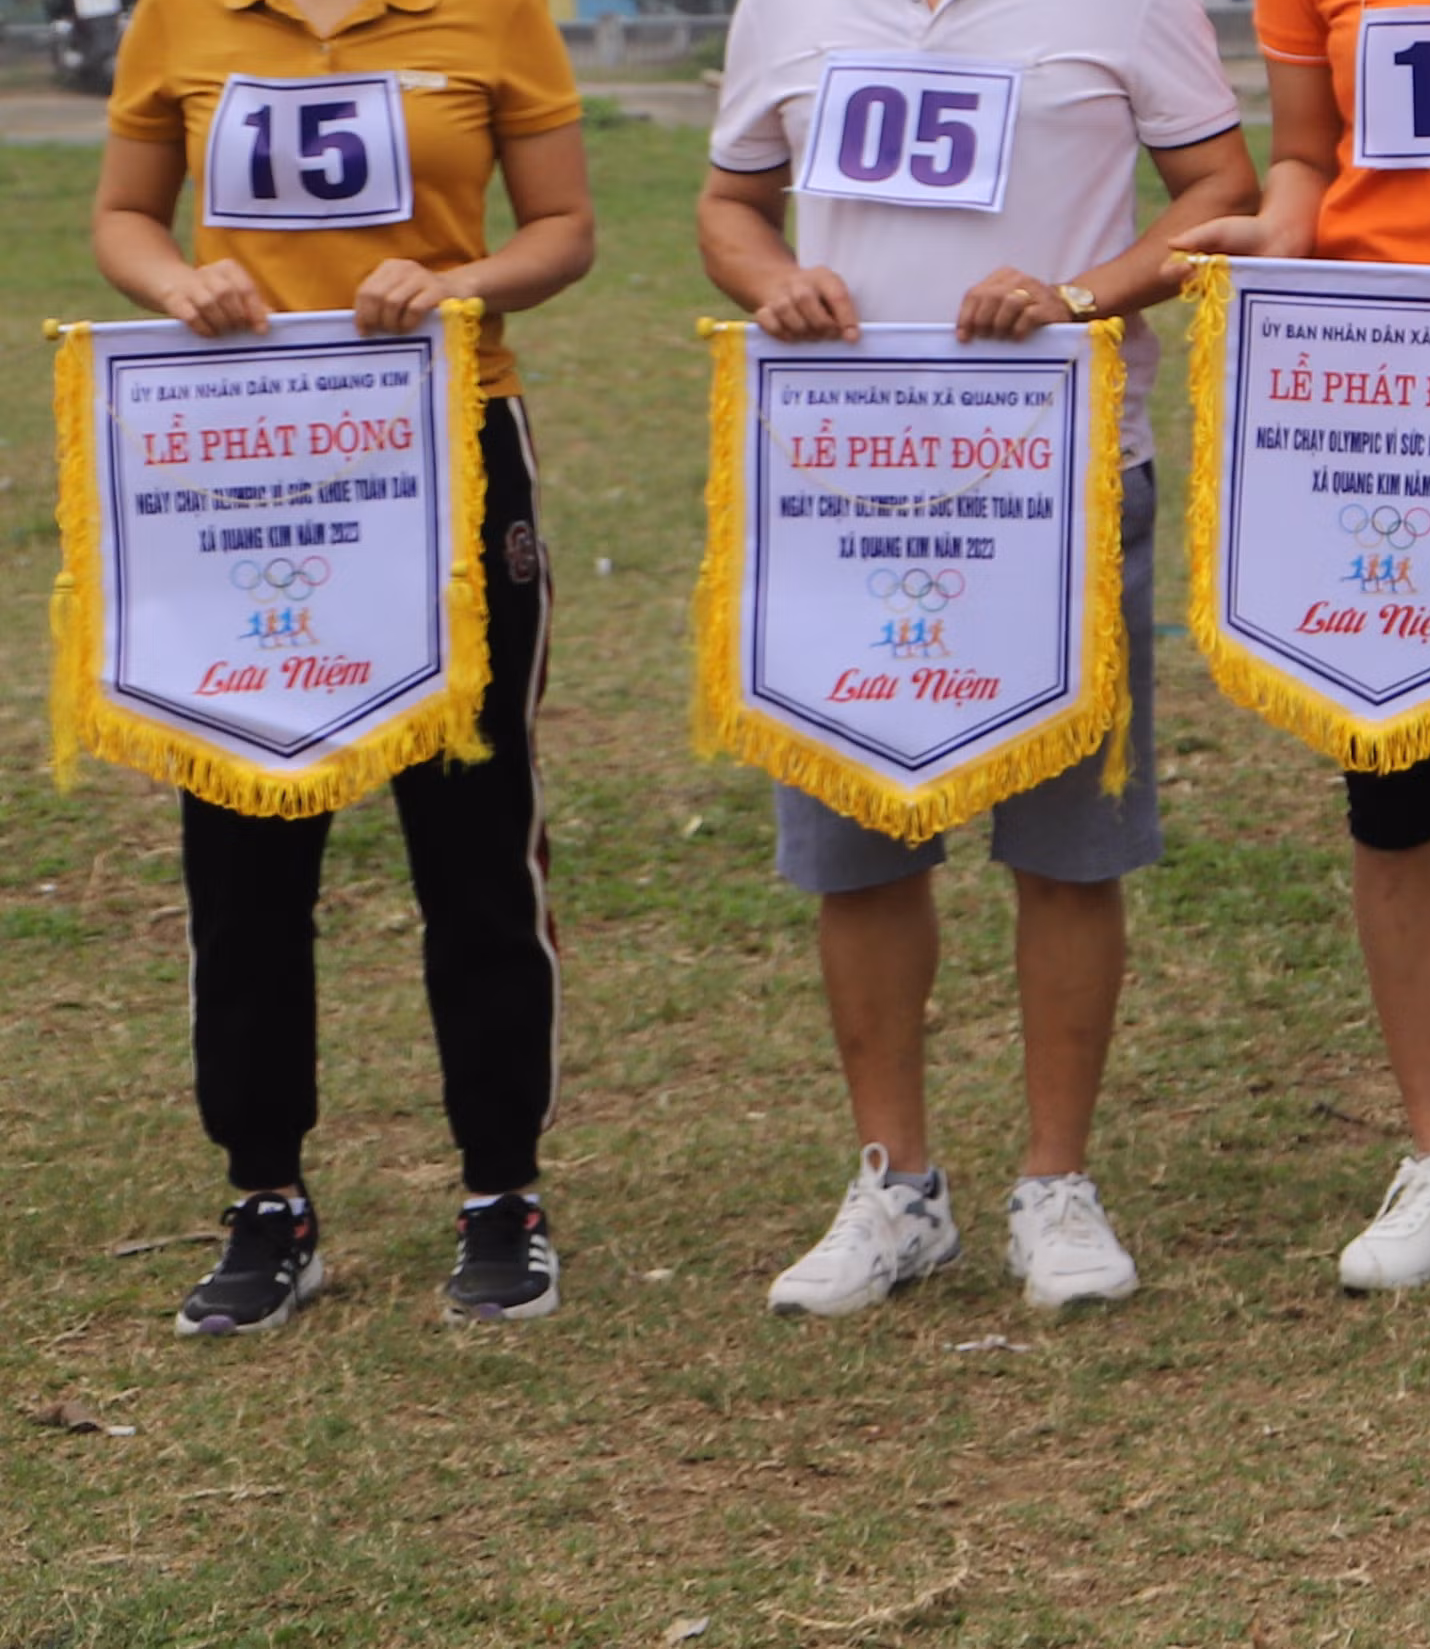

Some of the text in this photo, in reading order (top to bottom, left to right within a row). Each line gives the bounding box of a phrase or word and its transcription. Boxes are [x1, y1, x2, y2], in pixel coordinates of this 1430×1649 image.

[243, 100, 368, 200] 15
[837, 85, 980, 187] 05
[1269, 352, 1313, 402] LỄ
[1321, 363, 1417, 408] PHÁT
